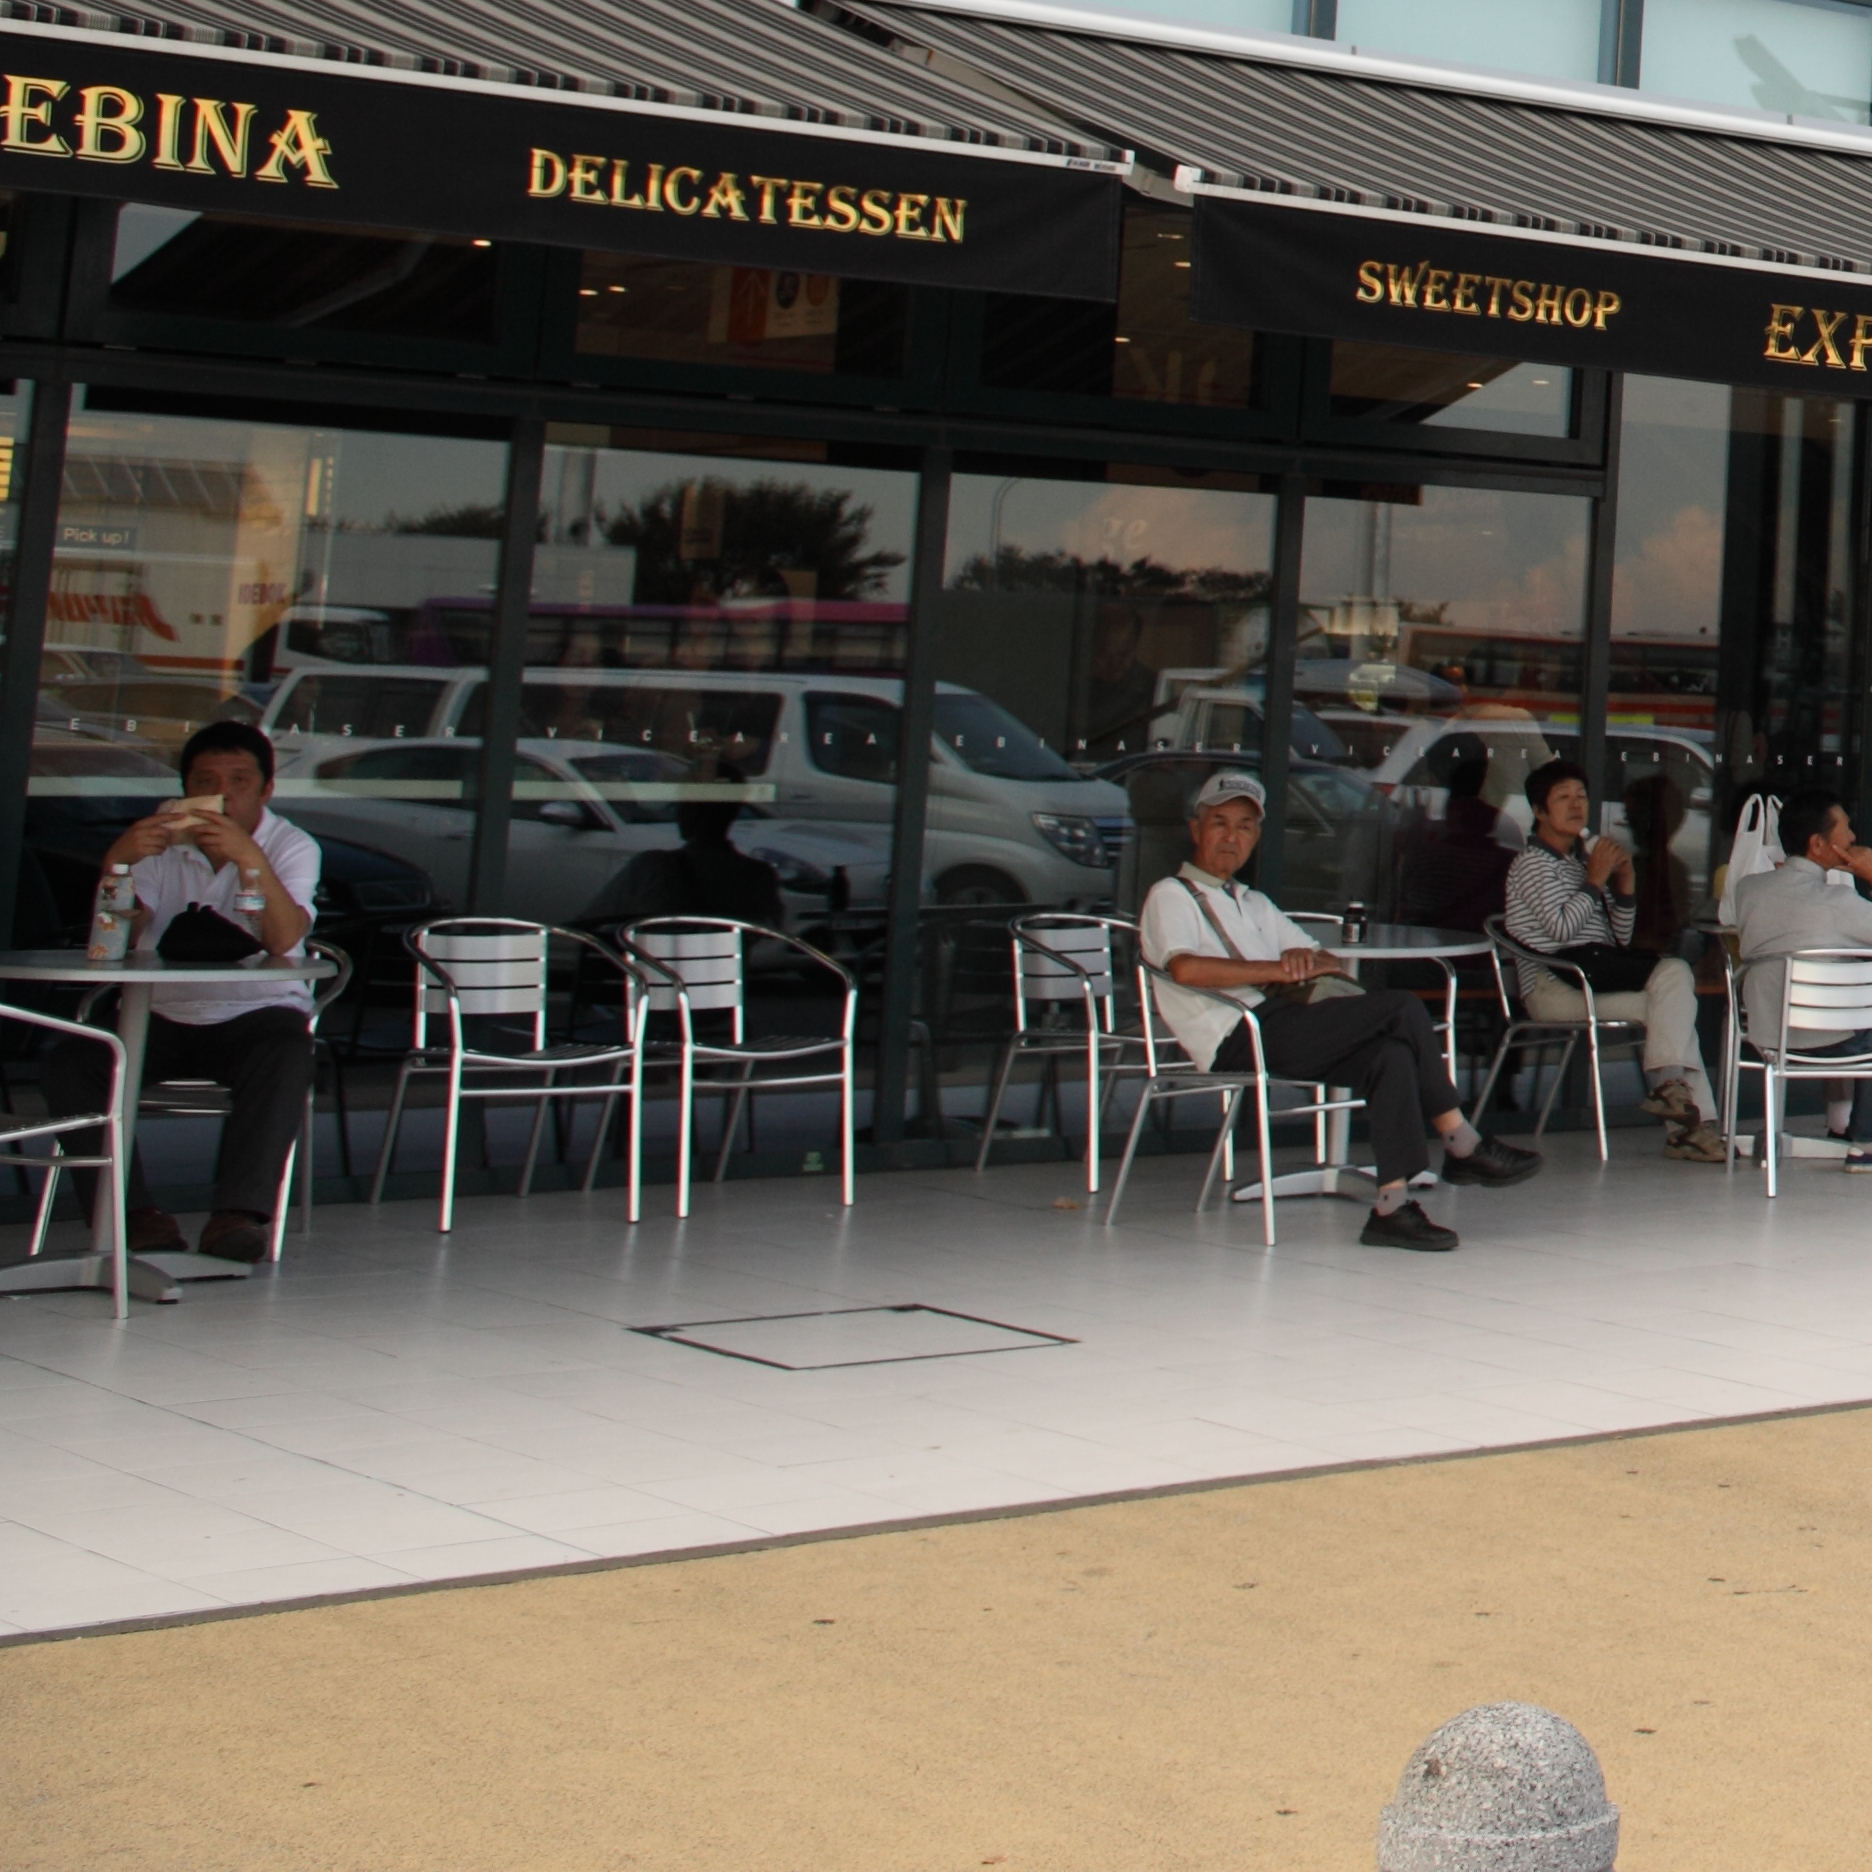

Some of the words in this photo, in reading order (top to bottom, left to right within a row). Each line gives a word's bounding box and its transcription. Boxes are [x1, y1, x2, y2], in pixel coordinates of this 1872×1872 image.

[0, 73, 340, 189] EBINA
[526, 146, 968, 244] DELICATESSEN
[1356, 258, 1621, 333] SWEETSHOP
[62, 527, 97, 544] Pick
[102, 529, 130, 546] up!
